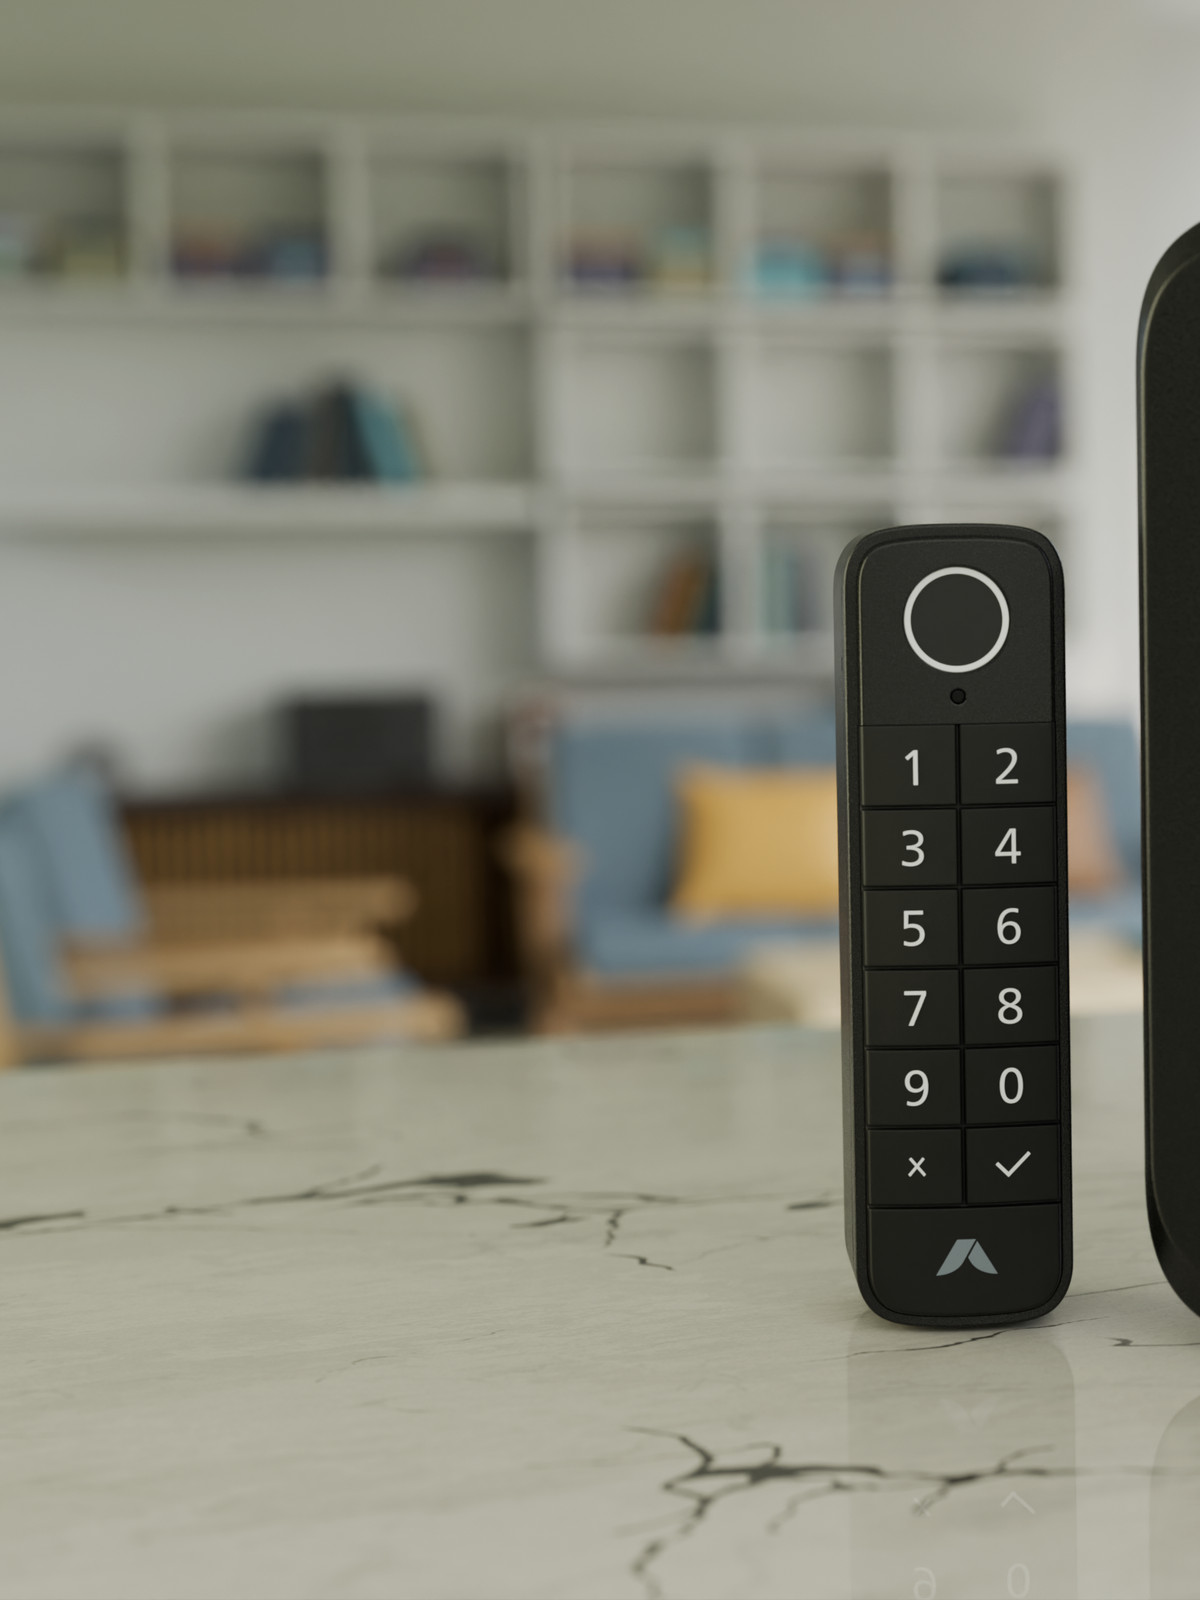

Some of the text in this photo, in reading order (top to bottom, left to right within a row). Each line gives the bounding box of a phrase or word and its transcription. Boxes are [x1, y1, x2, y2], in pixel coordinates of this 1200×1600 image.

[904, 747, 1019, 786] 1 2
[901, 827, 1022, 868] 3 4
[903, 907, 1022, 947] 5 6
[903, 987, 1023, 1027] 7 8
[904, 1066, 1024, 1107] 9 0
